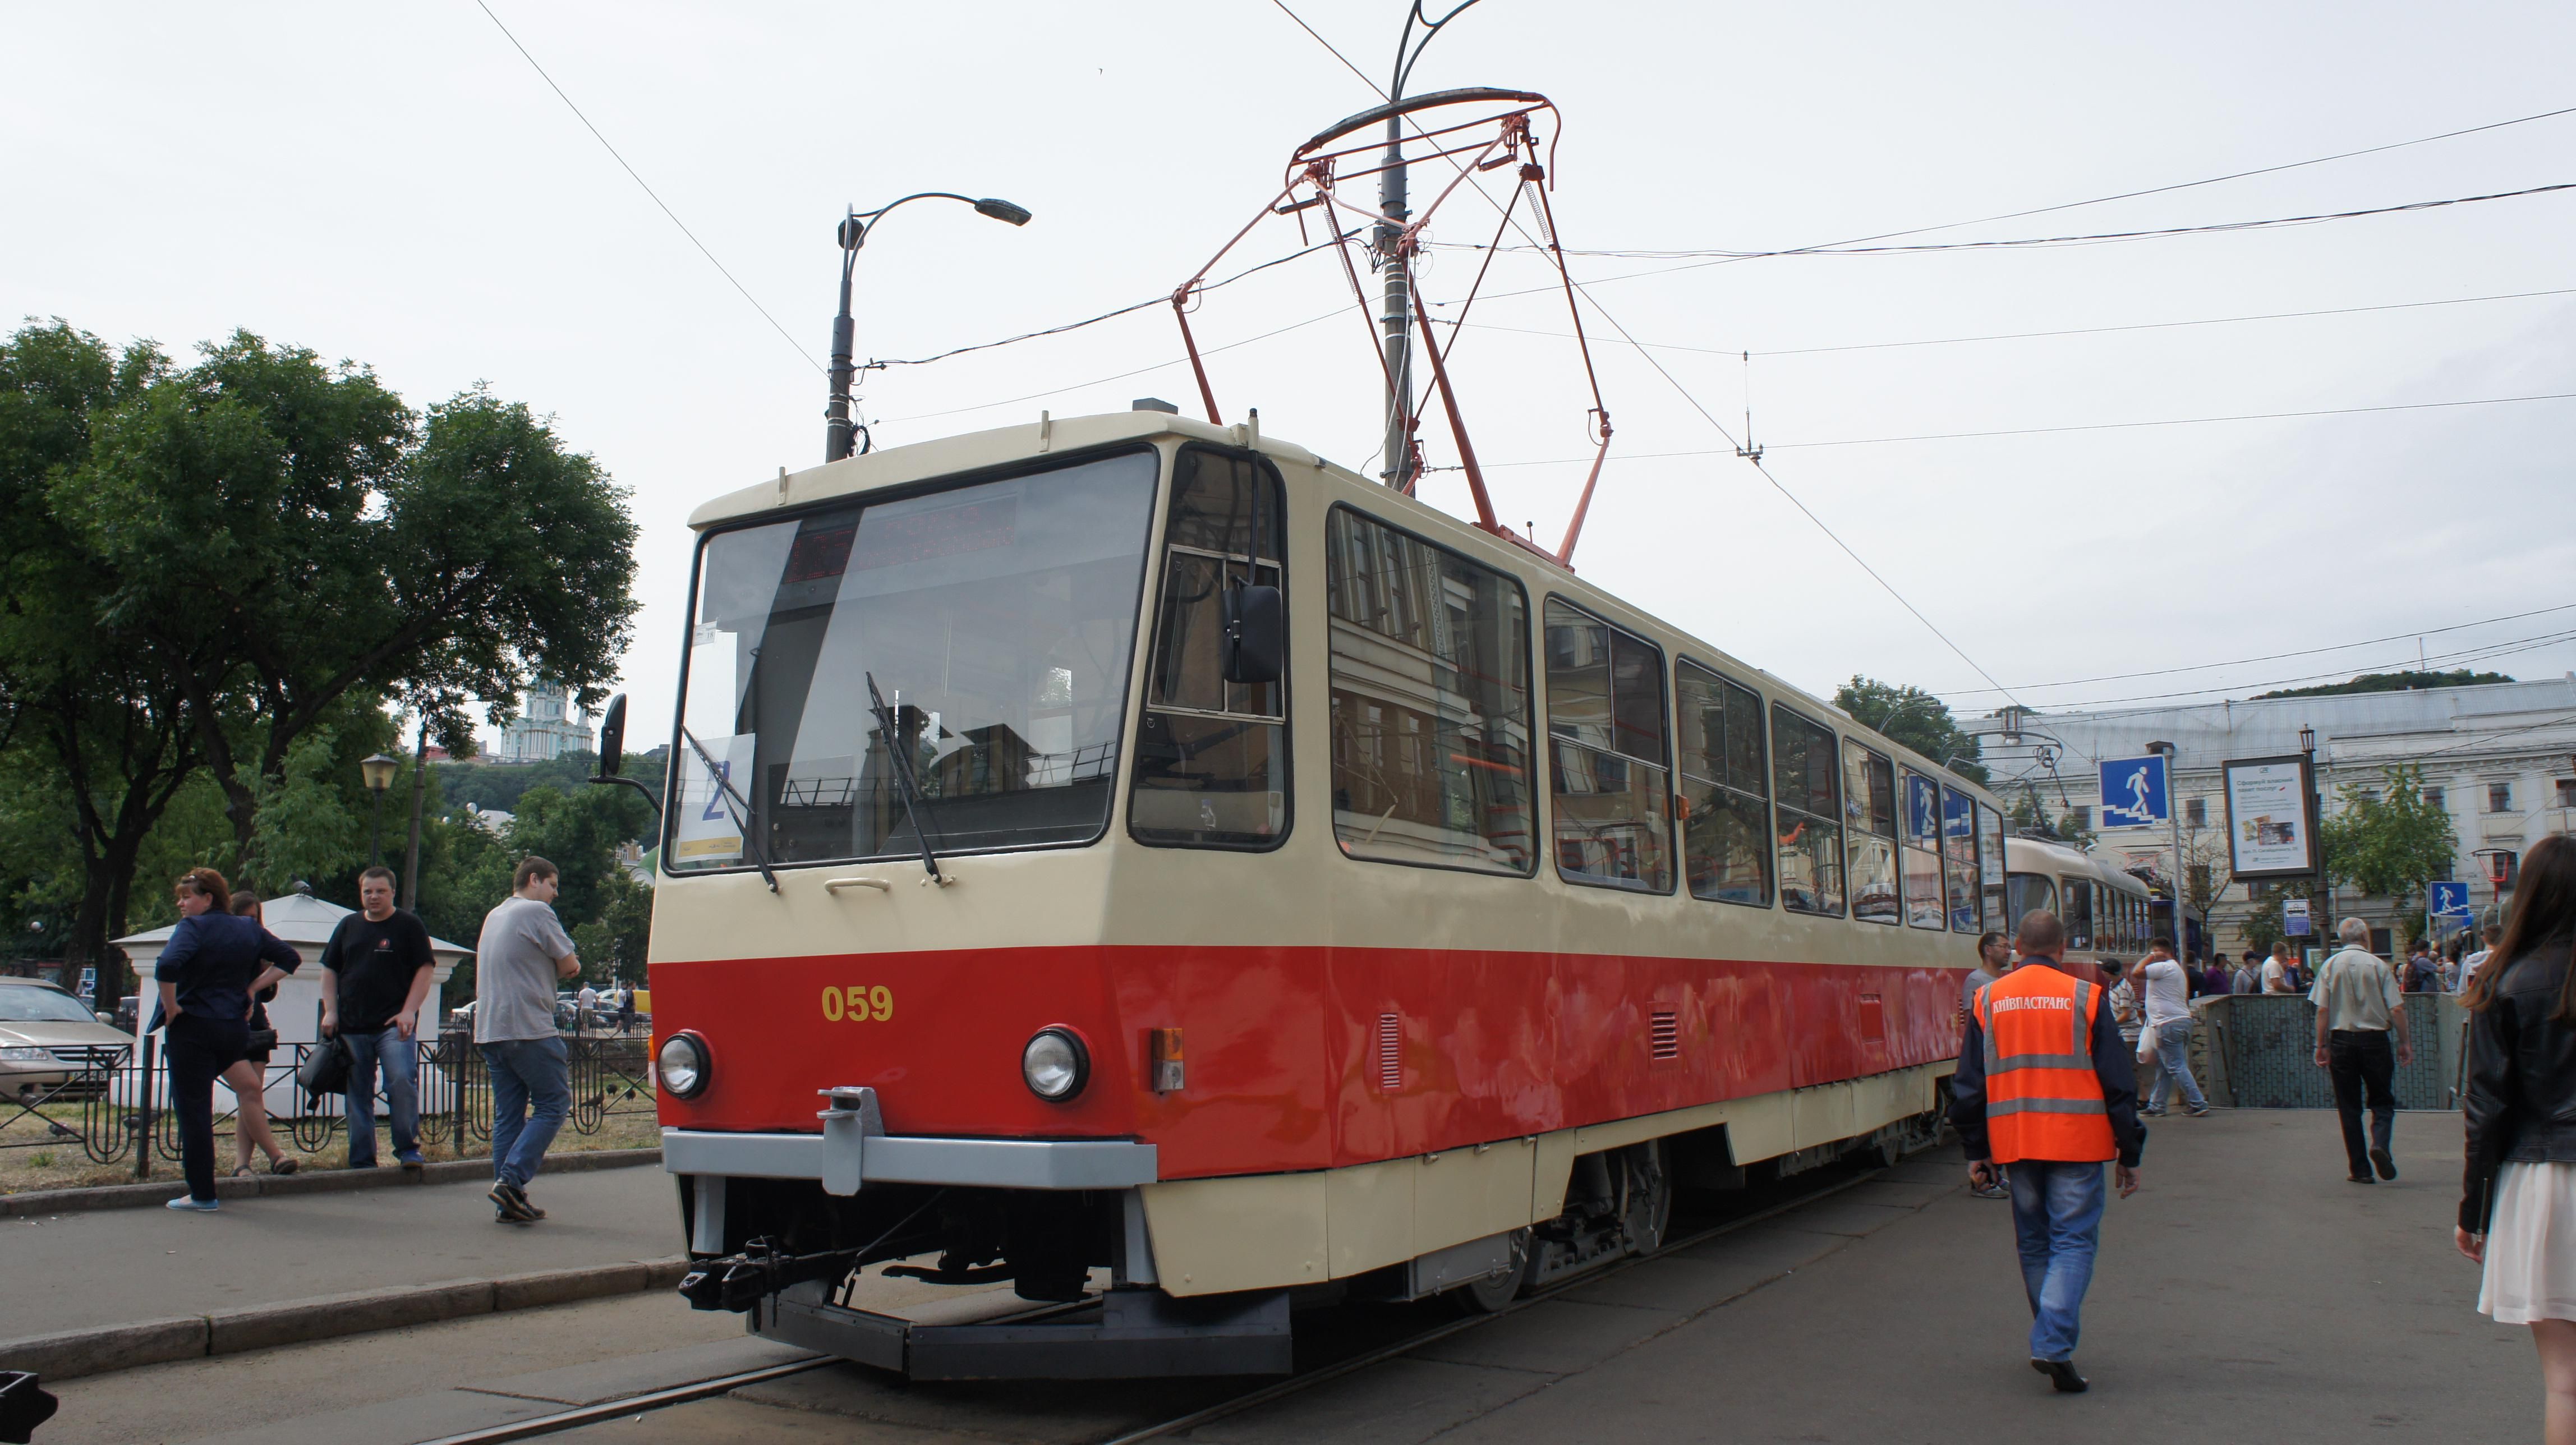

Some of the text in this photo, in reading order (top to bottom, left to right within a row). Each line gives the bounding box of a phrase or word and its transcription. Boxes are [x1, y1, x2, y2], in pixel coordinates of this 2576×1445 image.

[702, 761, 730, 821] 2
[822, 985, 893, 1021] 059
[1993, 996, 2072, 1014] КИЇВПАСТРАНС
